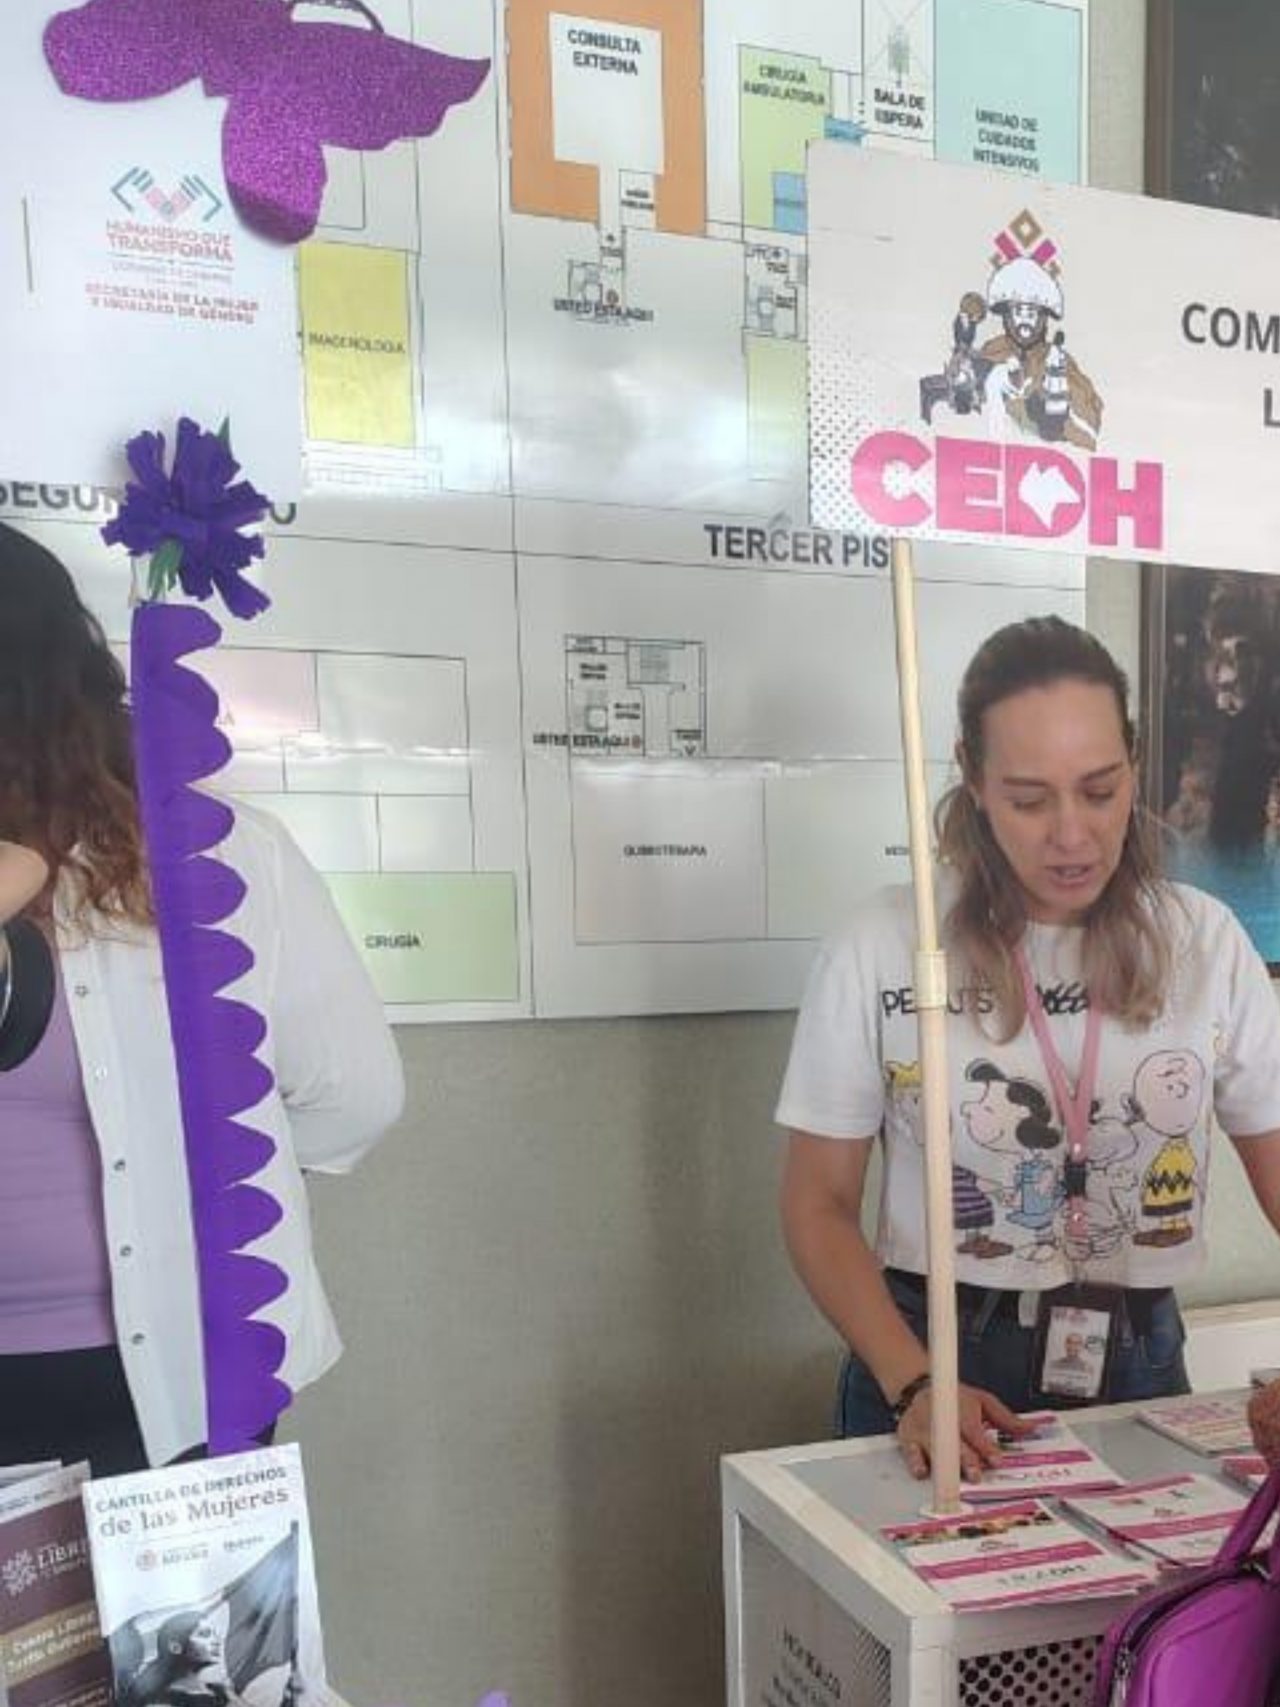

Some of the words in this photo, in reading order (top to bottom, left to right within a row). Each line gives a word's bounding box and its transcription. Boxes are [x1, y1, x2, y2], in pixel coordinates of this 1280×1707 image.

[566, 29, 642, 55] CONSULTA
[572, 51, 639, 77] EXTERNA
[874, 88, 907, 106] SALA
[909, 96, 925, 110] DE
[874, 108, 924, 129] ESPERA
[974, 108, 1016, 130] UNIDAD
[1017, 116, 1038, 133] DE
[976, 130, 1037, 152] CUIDADOS
[972, 149, 1040, 174] INTENSIVOS
[106, 233, 234, 263] TRANSFORMA
[850, 430, 1164, 553] CEDH
[703, 524, 833, 565] TERCER
[95, 1488, 177, 1513] CARTILLA
[180, 1484, 200, 1497] DE
[204, 1466, 287, 1492] DERECHOS
[100, 1516, 132, 1537] de
[140, 1509, 180, 1530] las
[187, 1488, 290, 1522] Mujeres
